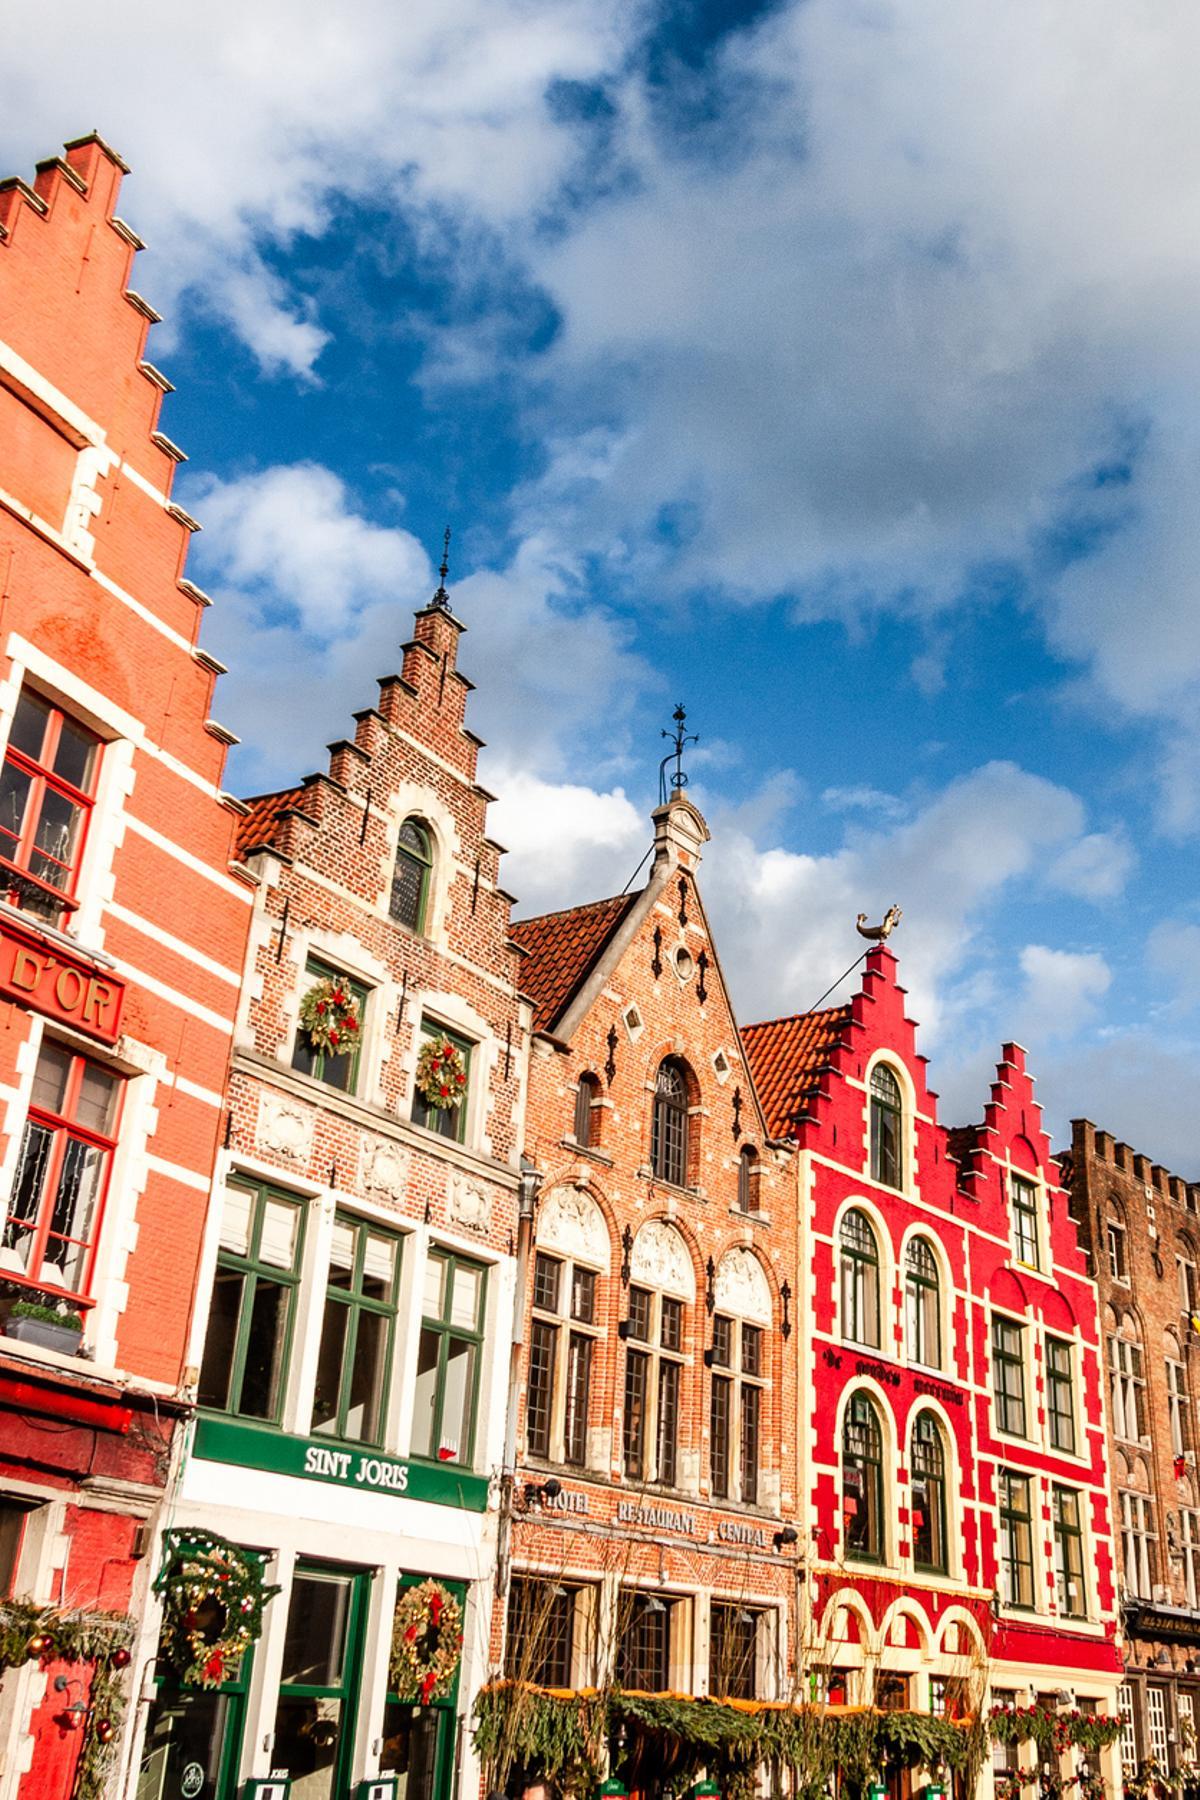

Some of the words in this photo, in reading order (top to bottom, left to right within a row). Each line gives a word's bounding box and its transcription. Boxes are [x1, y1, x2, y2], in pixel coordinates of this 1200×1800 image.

[11, 950, 113, 1028] D'OR
[304, 1446, 352, 1479] SINT
[355, 1457, 409, 1491] JORIS
[617, 1500, 696, 1535] RESTAURANT
[718, 1519, 767, 1549] CENTRAL
